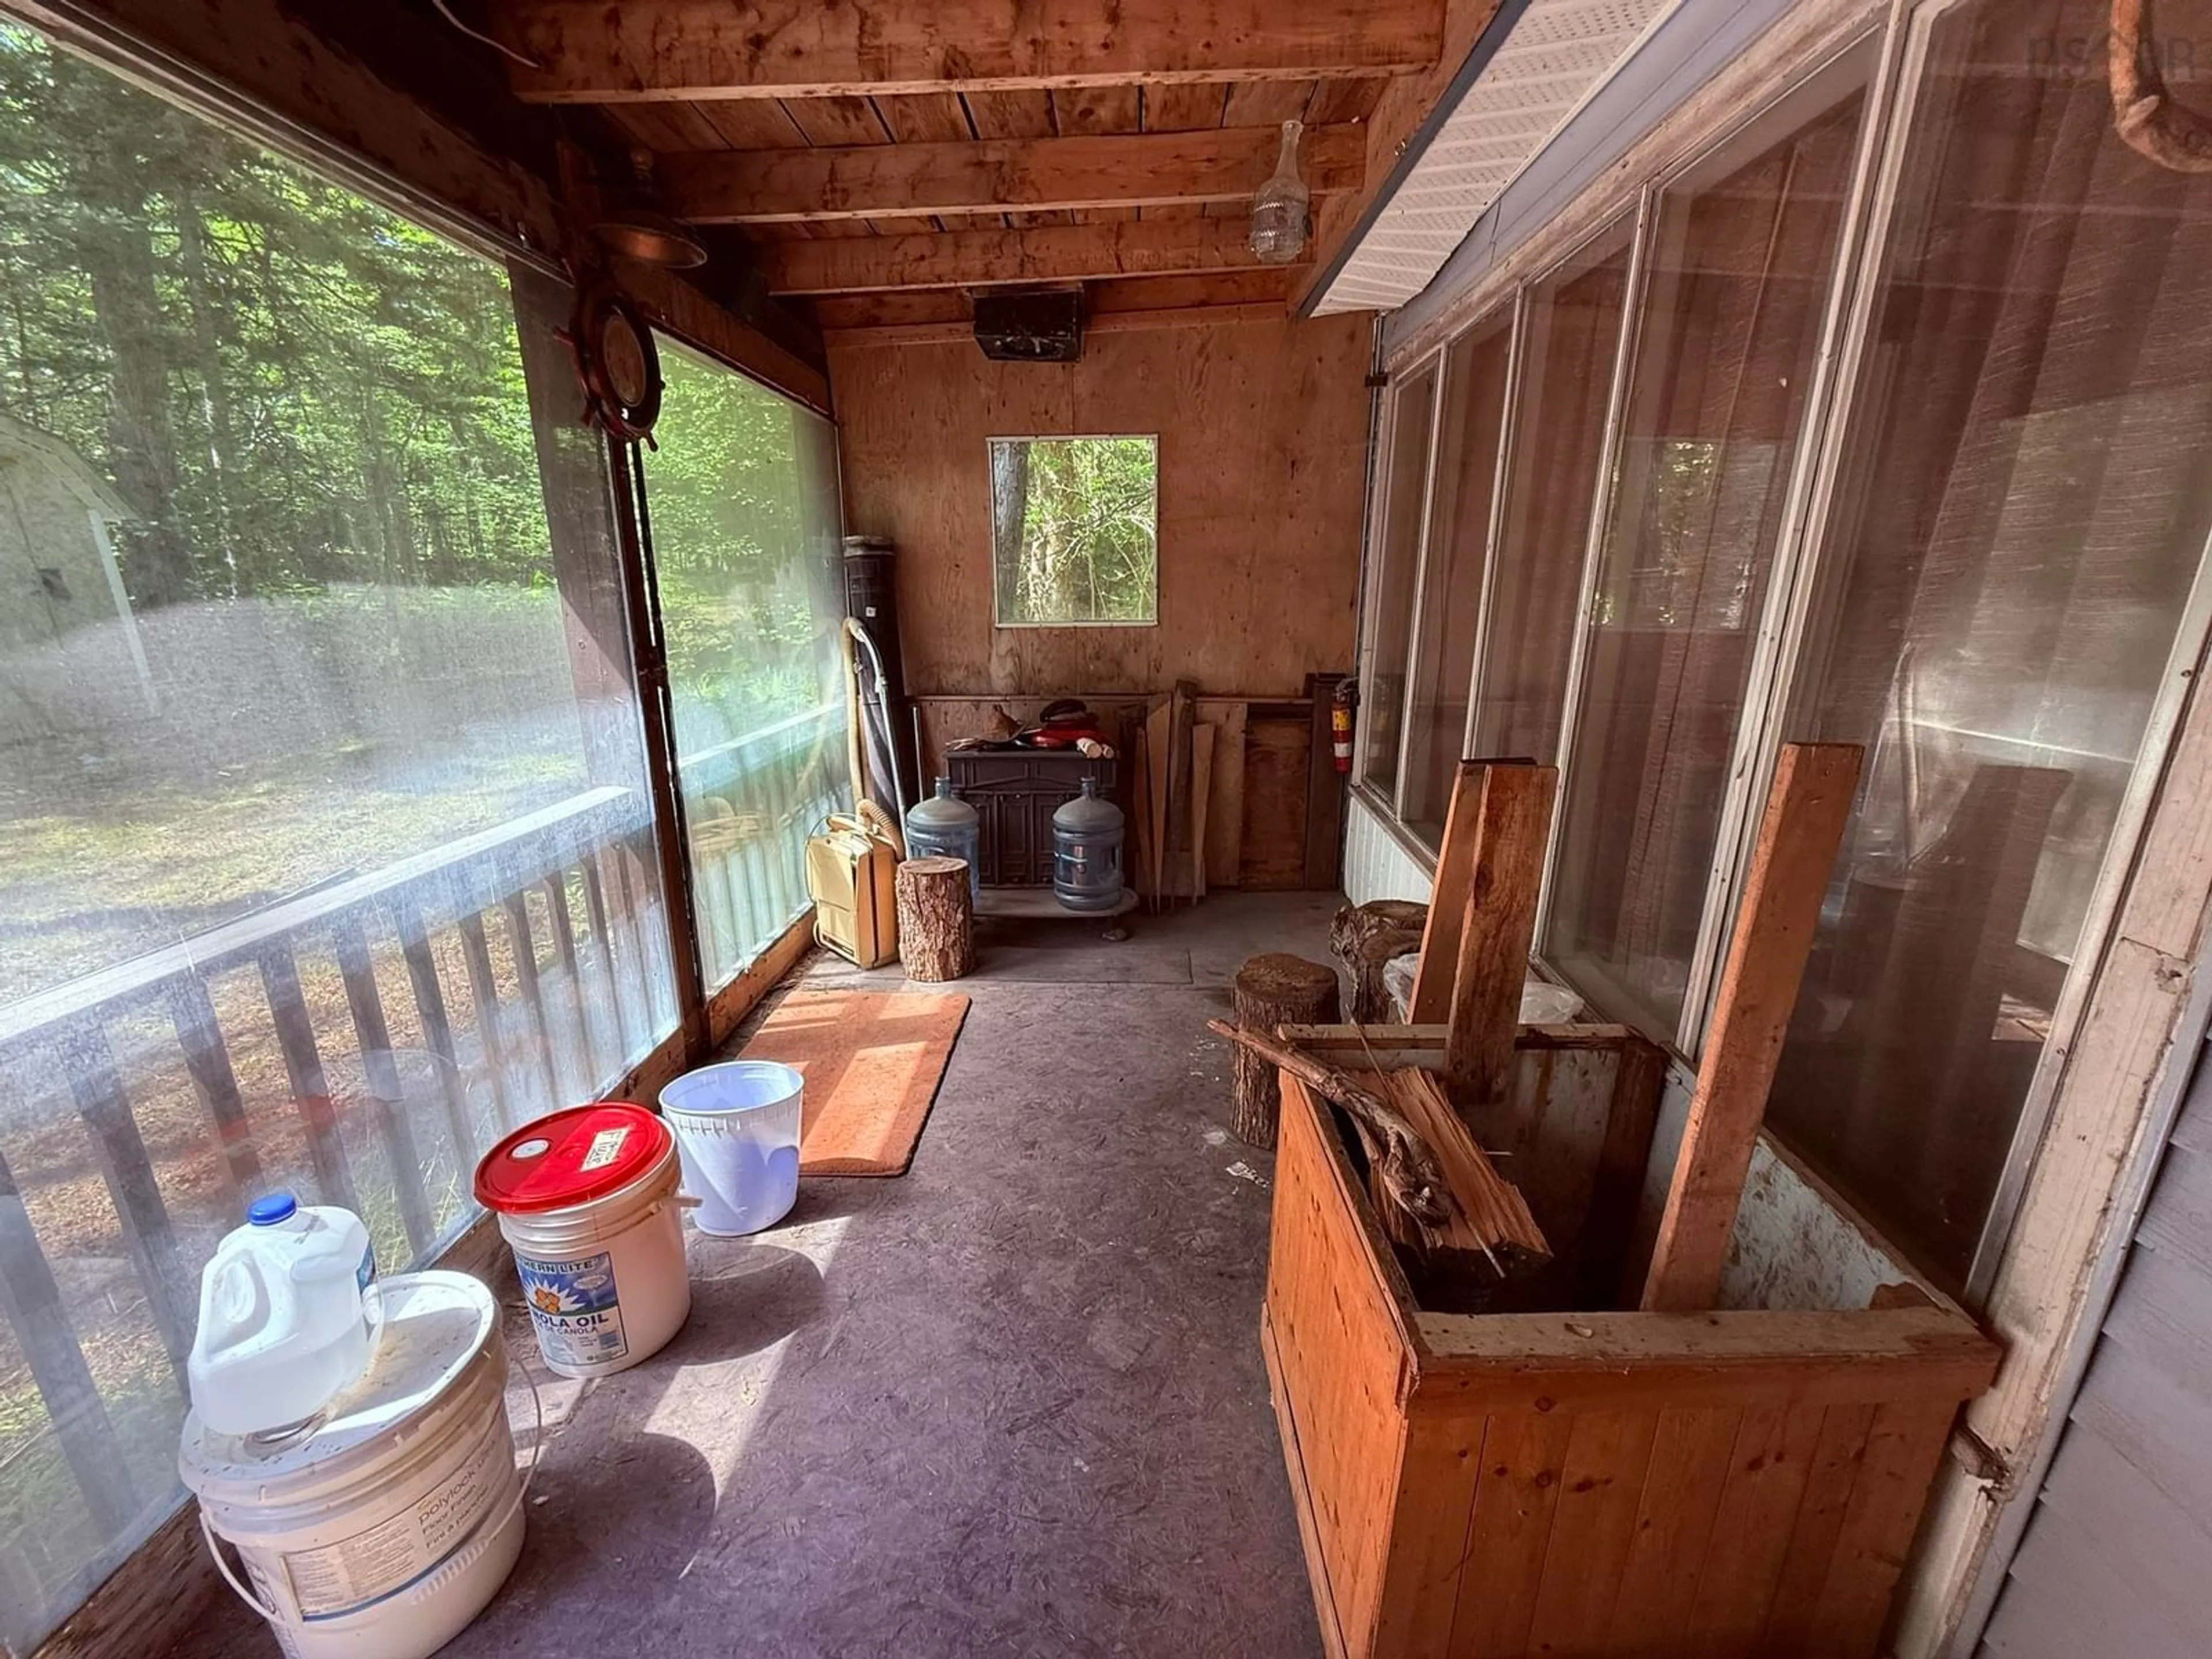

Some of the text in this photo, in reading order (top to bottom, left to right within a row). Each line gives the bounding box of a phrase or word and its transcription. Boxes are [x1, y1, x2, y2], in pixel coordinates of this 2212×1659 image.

[560, 1261, 593, 1273] LITE
[577, 1313, 609, 1327] OIL
[557, 1326, 599, 1335] CANOLA
[418, 1470, 476, 1525] polylock
